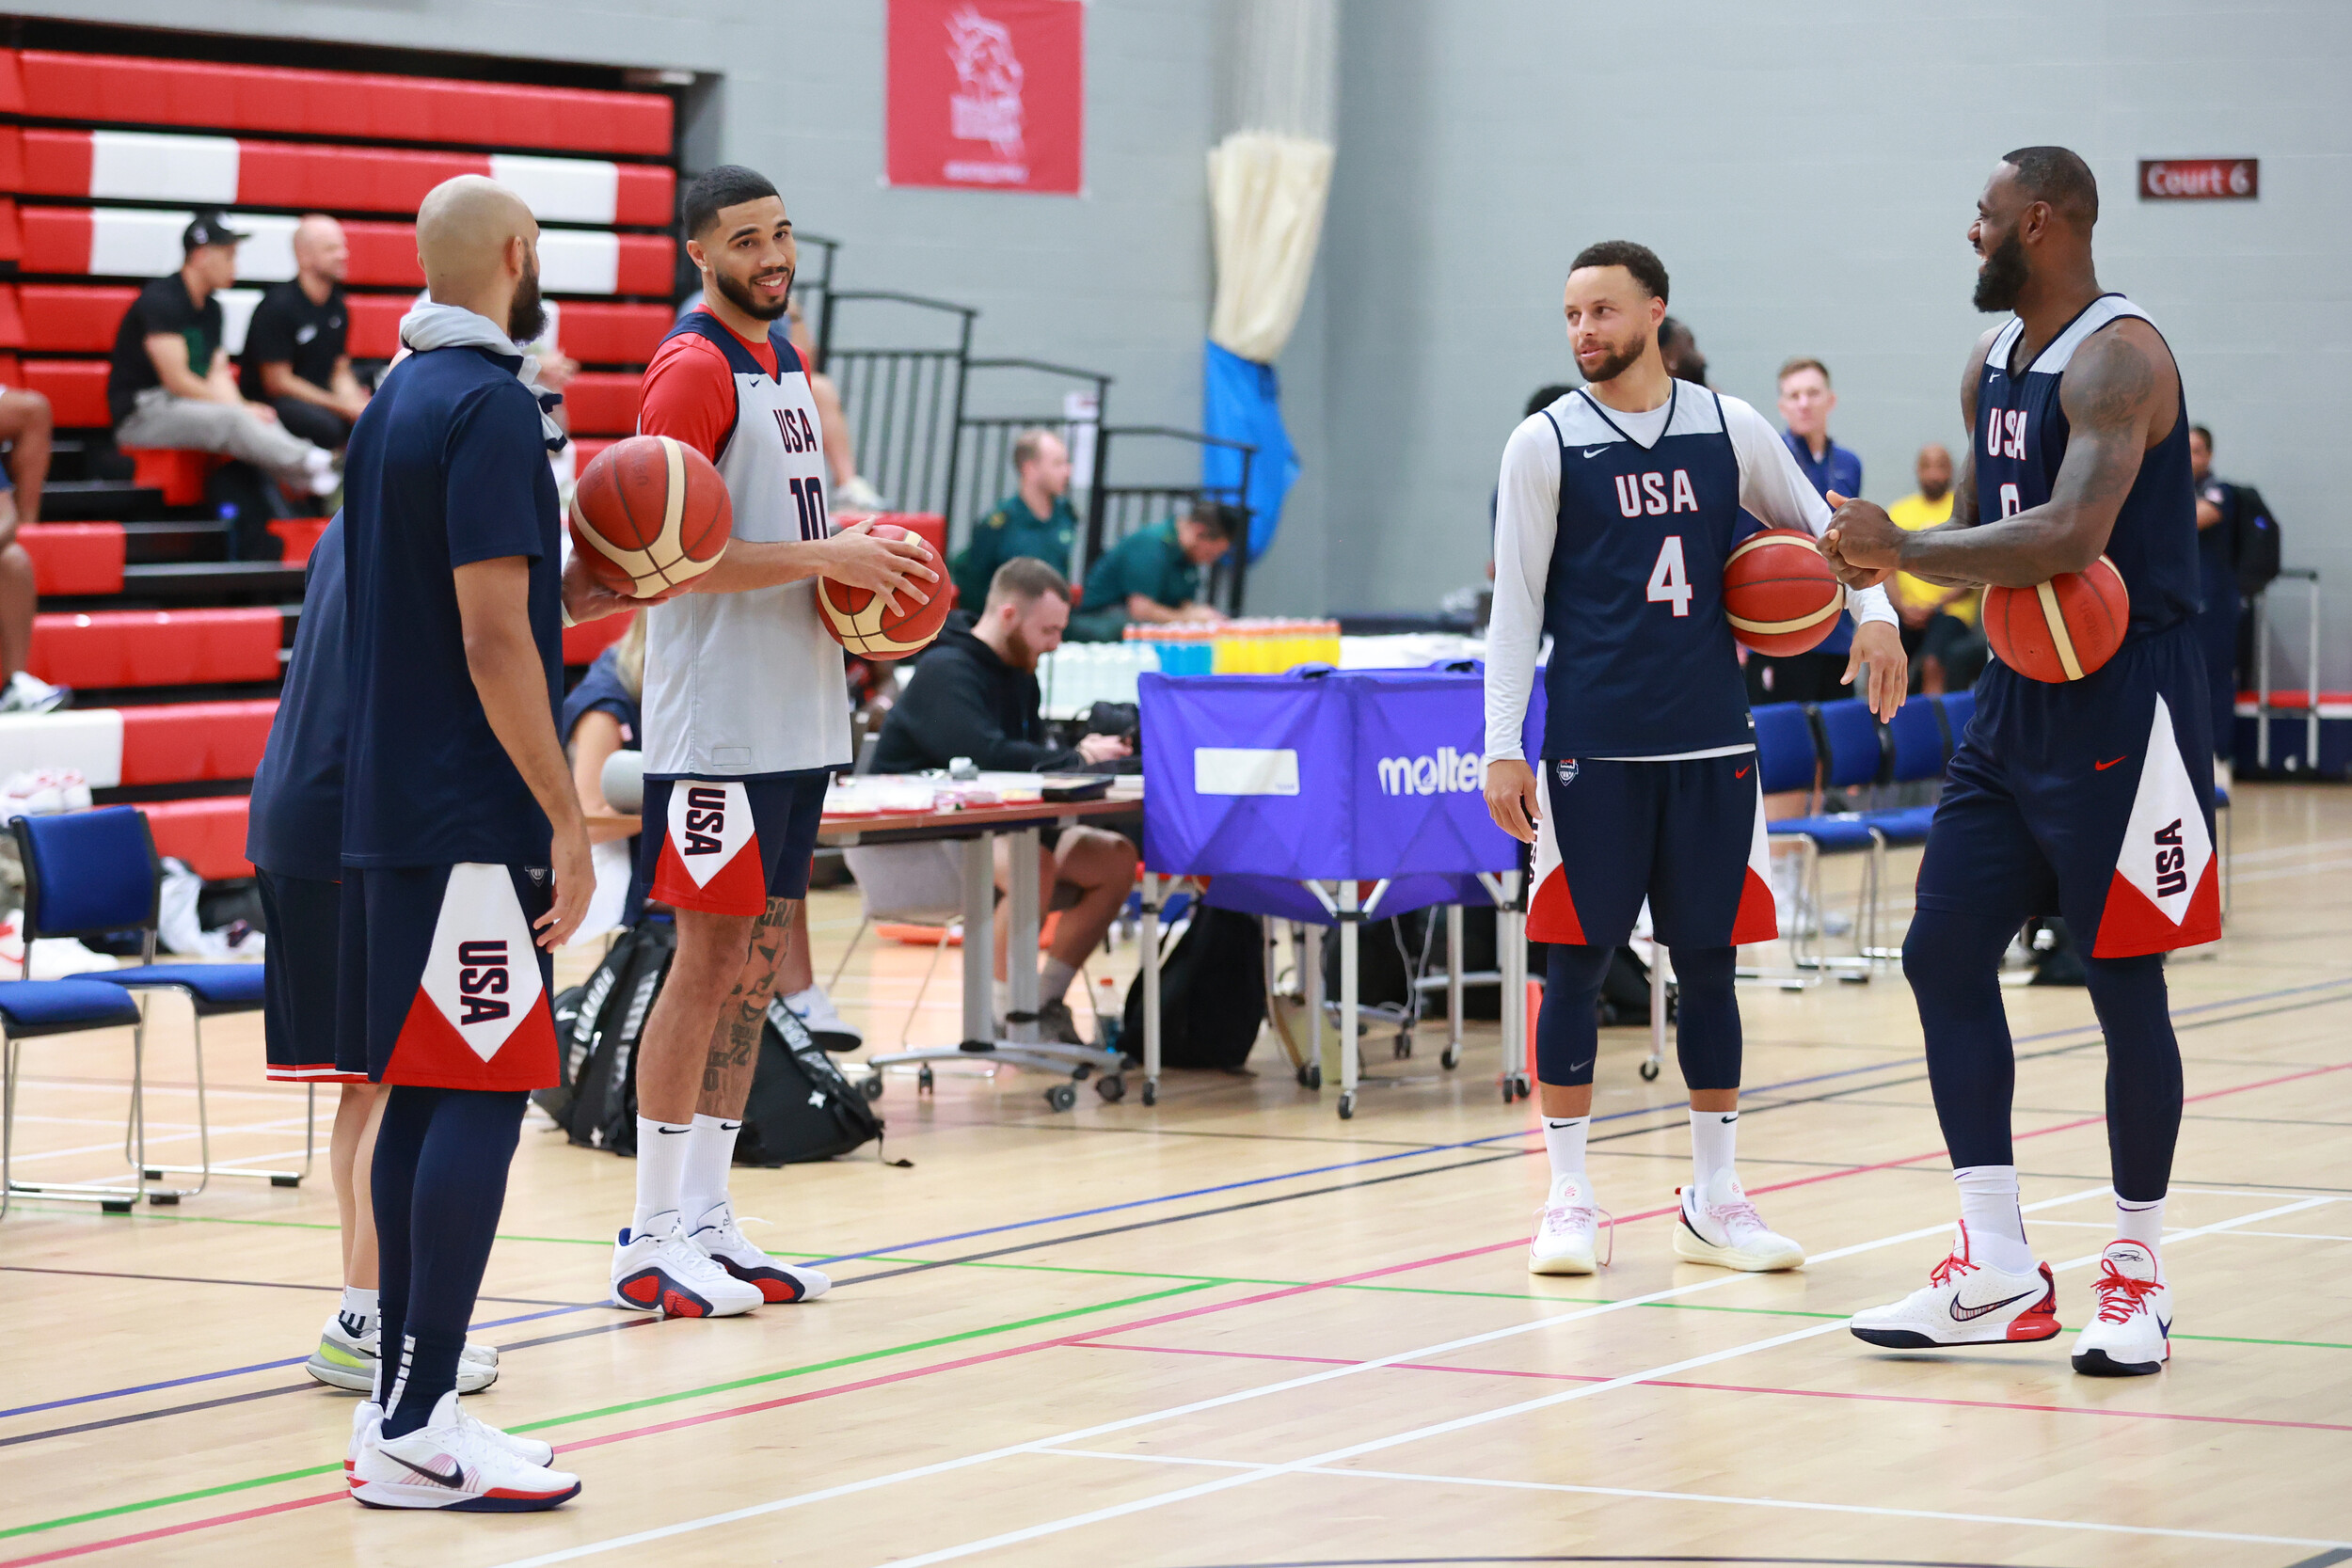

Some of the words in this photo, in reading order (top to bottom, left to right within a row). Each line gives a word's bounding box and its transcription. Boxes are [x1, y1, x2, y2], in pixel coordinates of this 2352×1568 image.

[2147, 163, 2224, 196] Court
[2230, 163, 2250, 195] 6
[772, 408, 818, 453] USA
[1987, 407, 2028, 461] USA
[789, 477, 829, 542] 10
[1614, 468, 1699, 518] USA
[1645, 535, 1693, 617] 4
[684, 787, 726, 857] USA
[2153, 817, 2187, 898] USA
[458, 940, 510, 1026] USA
